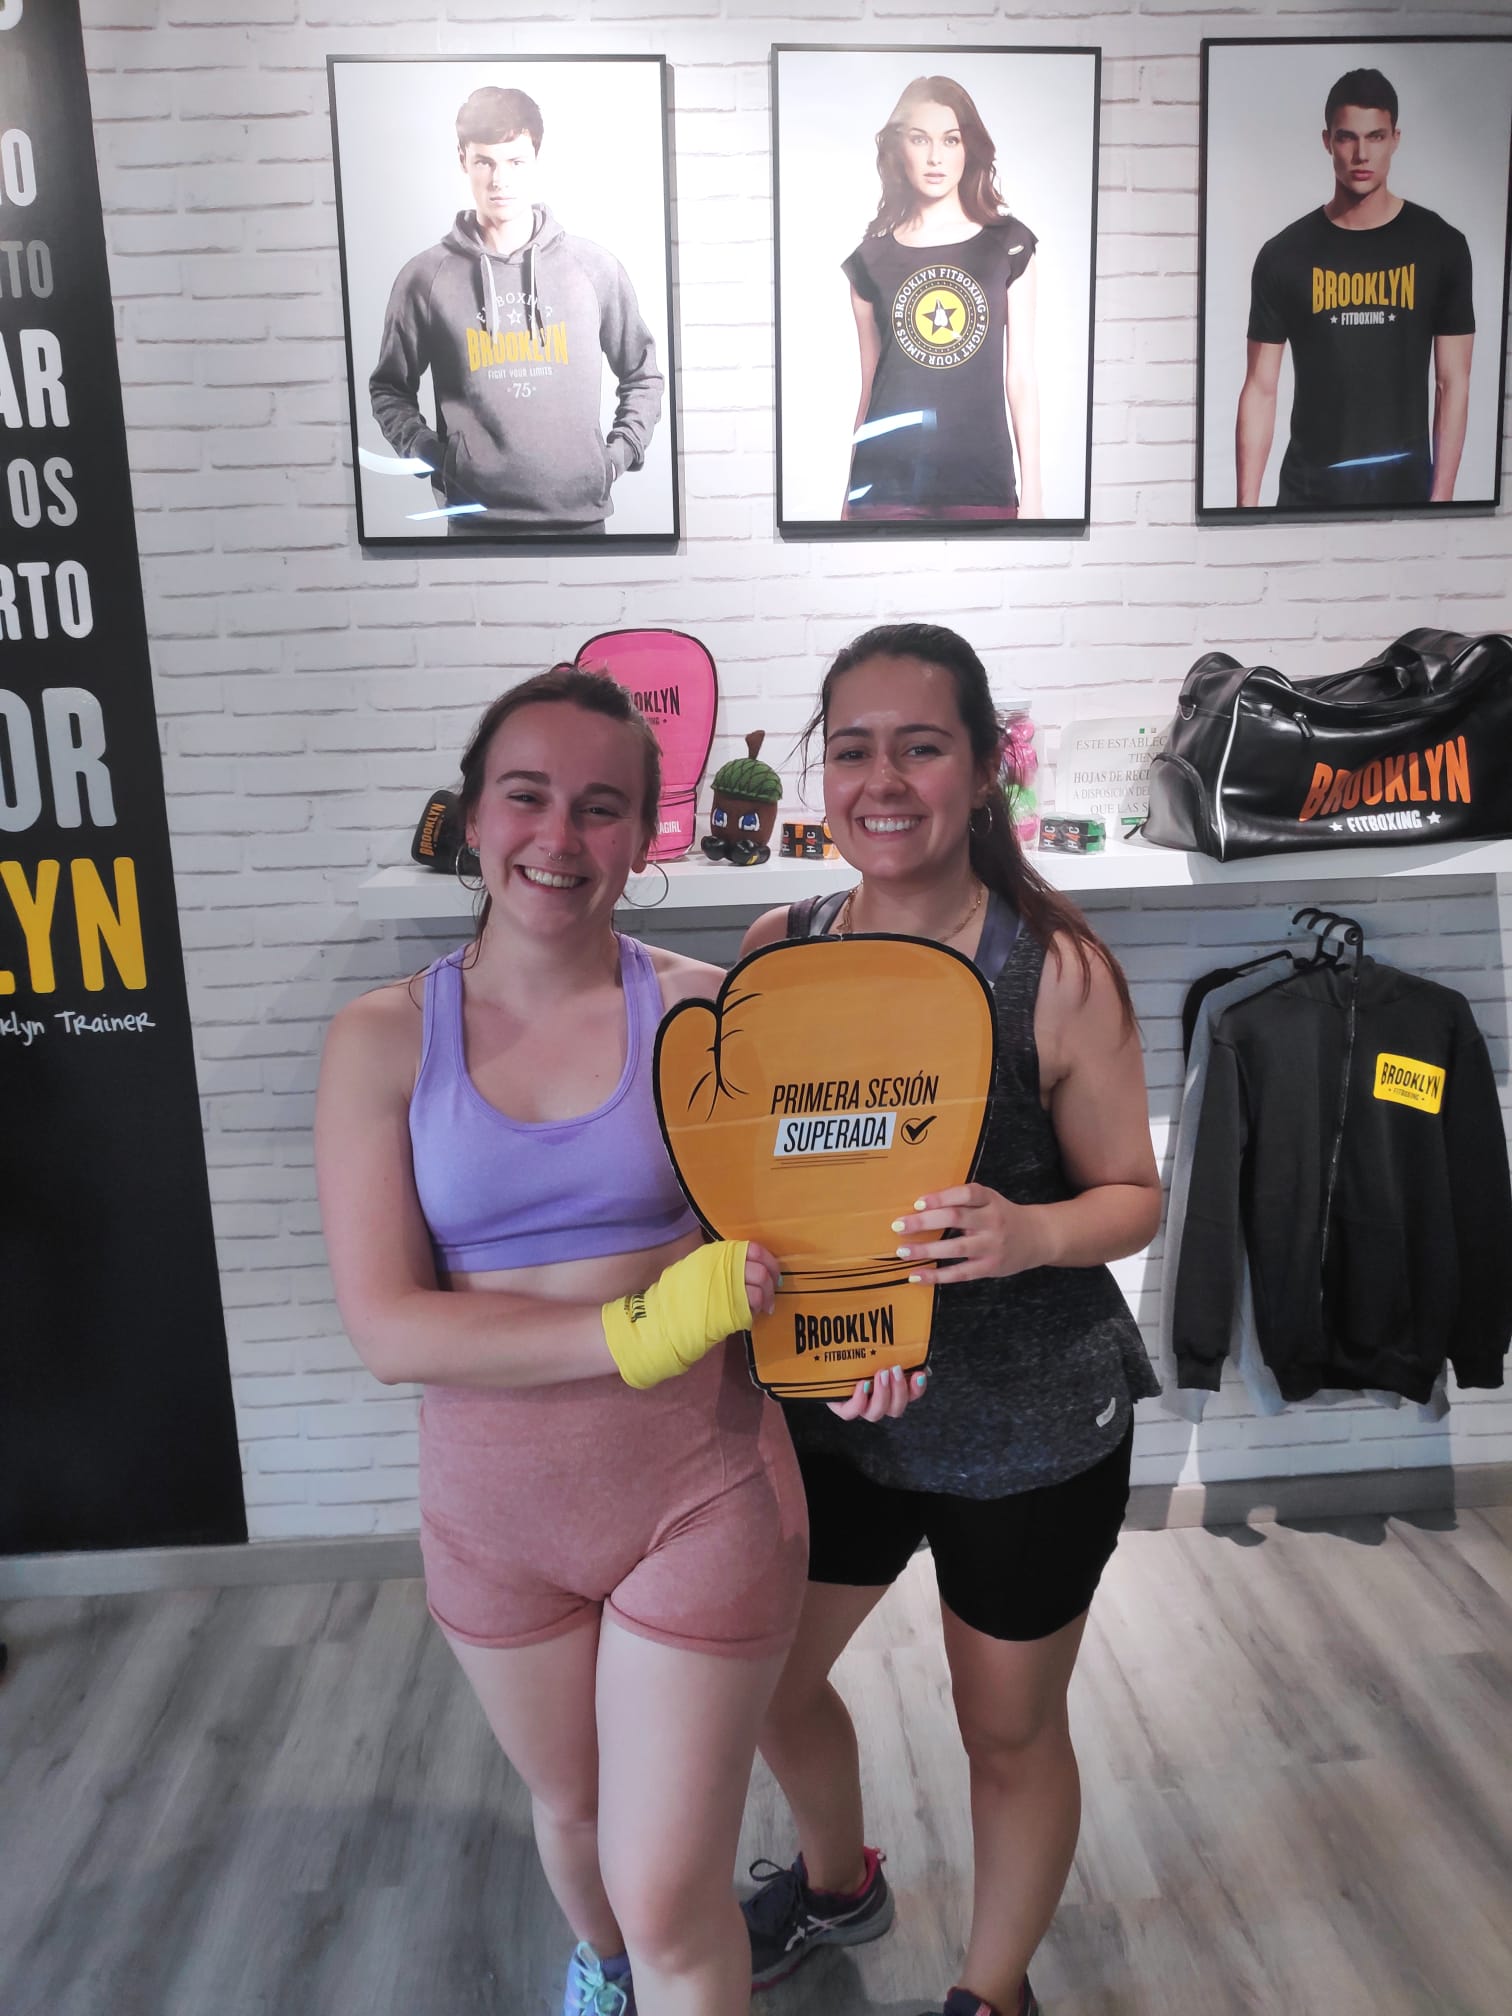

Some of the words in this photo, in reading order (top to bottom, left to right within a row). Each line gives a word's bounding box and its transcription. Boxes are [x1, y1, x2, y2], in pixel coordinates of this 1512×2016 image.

[894, 268, 937, 318] BROOKLYN
[940, 268, 986, 314] FITBOXING
[1312, 263, 1415, 314] BROOKLYN
[1341, 311, 1385, 326] FITBOXING
[466, 321, 569, 373] BROOKLYN
[896, 328, 926, 362] LIMITS
[962, 323, 985, 358] FIGHT
[510, 368, 527, 378] YOUR
[530, 366, 553, 377] LIMITS
[928, 352, 961, 365] YOUR
[512, 382, 532, 399] 75
[0, 560, 93, 640] RTO
[631, 685, 680, 716] OKLYN
[1074, 770, 1107, 784] HOJAS
[1110, 770, 1122, 782] DE
[1299, 735, 1471, 823] BROOKLYN
[1118, 801, 1139, 814] LAS
[1347, 810, 1422, 832] FITBOXING
[419, 803, 447, 856] BROOKLYN
[0, 857, 147, 995] YN
[770, 1080, 860, 1115] PRIMERA
[865, 1069, 939, 1109] SESIÓN
[1381, 1062, 1440, 1099] BROOKLYN
[783, 1116, 887, 1152] SUPERADA
[794, 1304, 894, 1355] BROOKLYN
[824, 1347, 866, 1363] FITBOXING
